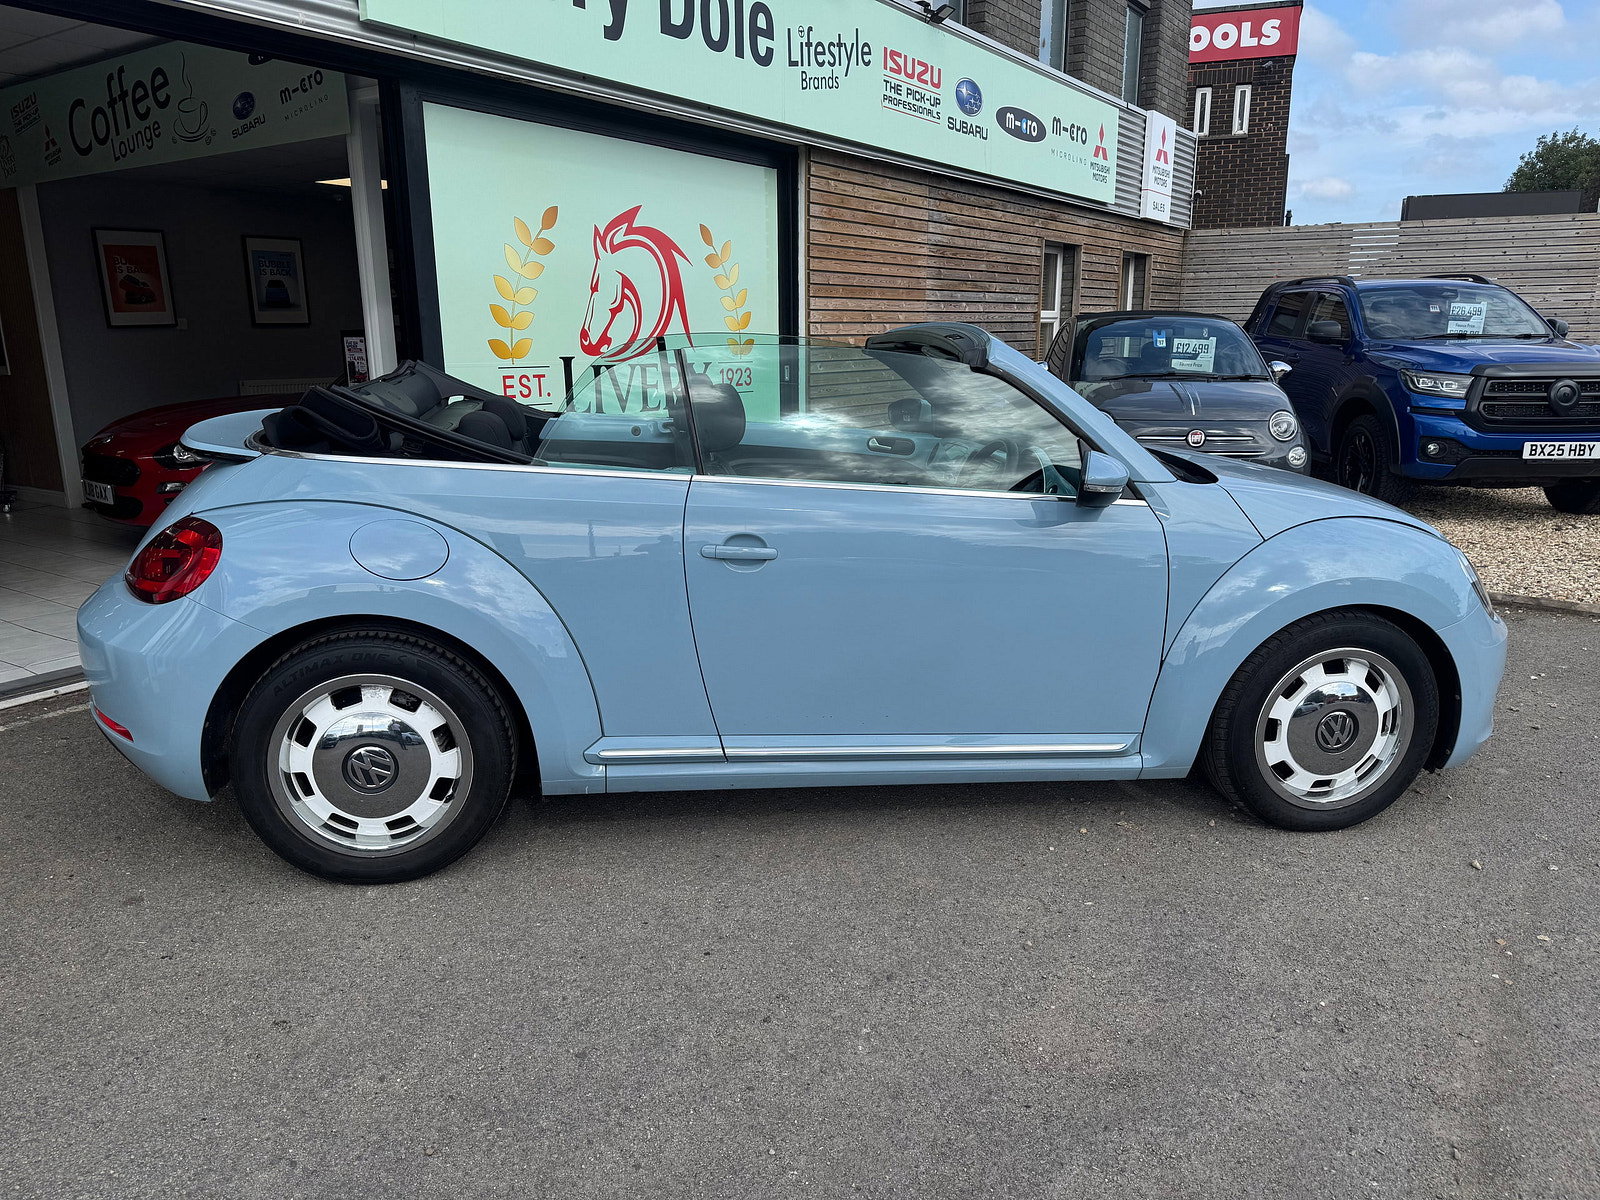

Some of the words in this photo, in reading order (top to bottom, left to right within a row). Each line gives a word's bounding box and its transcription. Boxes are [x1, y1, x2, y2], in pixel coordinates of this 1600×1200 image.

[787, 26, 872, 76] Lifestyle
[800, 70, 839, 90] Brands
[883, 46, 942, 89] ISUZU
[11, 91, 37, 120] ISUZU
[883, 79, 902, 96] THE
[906, 88, 941, 108] PICK-UP
[69, 65, 171, 156] Coffee
[284, 94, 329, 120] MICROLINO
[883, 94, 941, 120] PROFESSIONALS
[231, 114, 266, 139] SUBARU
[947, 116, 988, 140] SUBARU
[111, 121, 161, 161] Lounge
[1050, 147, 1088, 166] MICROLINO
[1089, 160, 1110, 174] MITSUBISHI
[1092, 171, 1108, 184] MOTORS
[1152, 200, 1166, 213] SALES
[1176, 342, 1210, 353] £12,499
[502, 374, 551, 400] EST.
[719, 368, 752, 387] 1923
[1529, 444, 1565, 456] BX25
[1568, 444, 1596, 456] HBY
